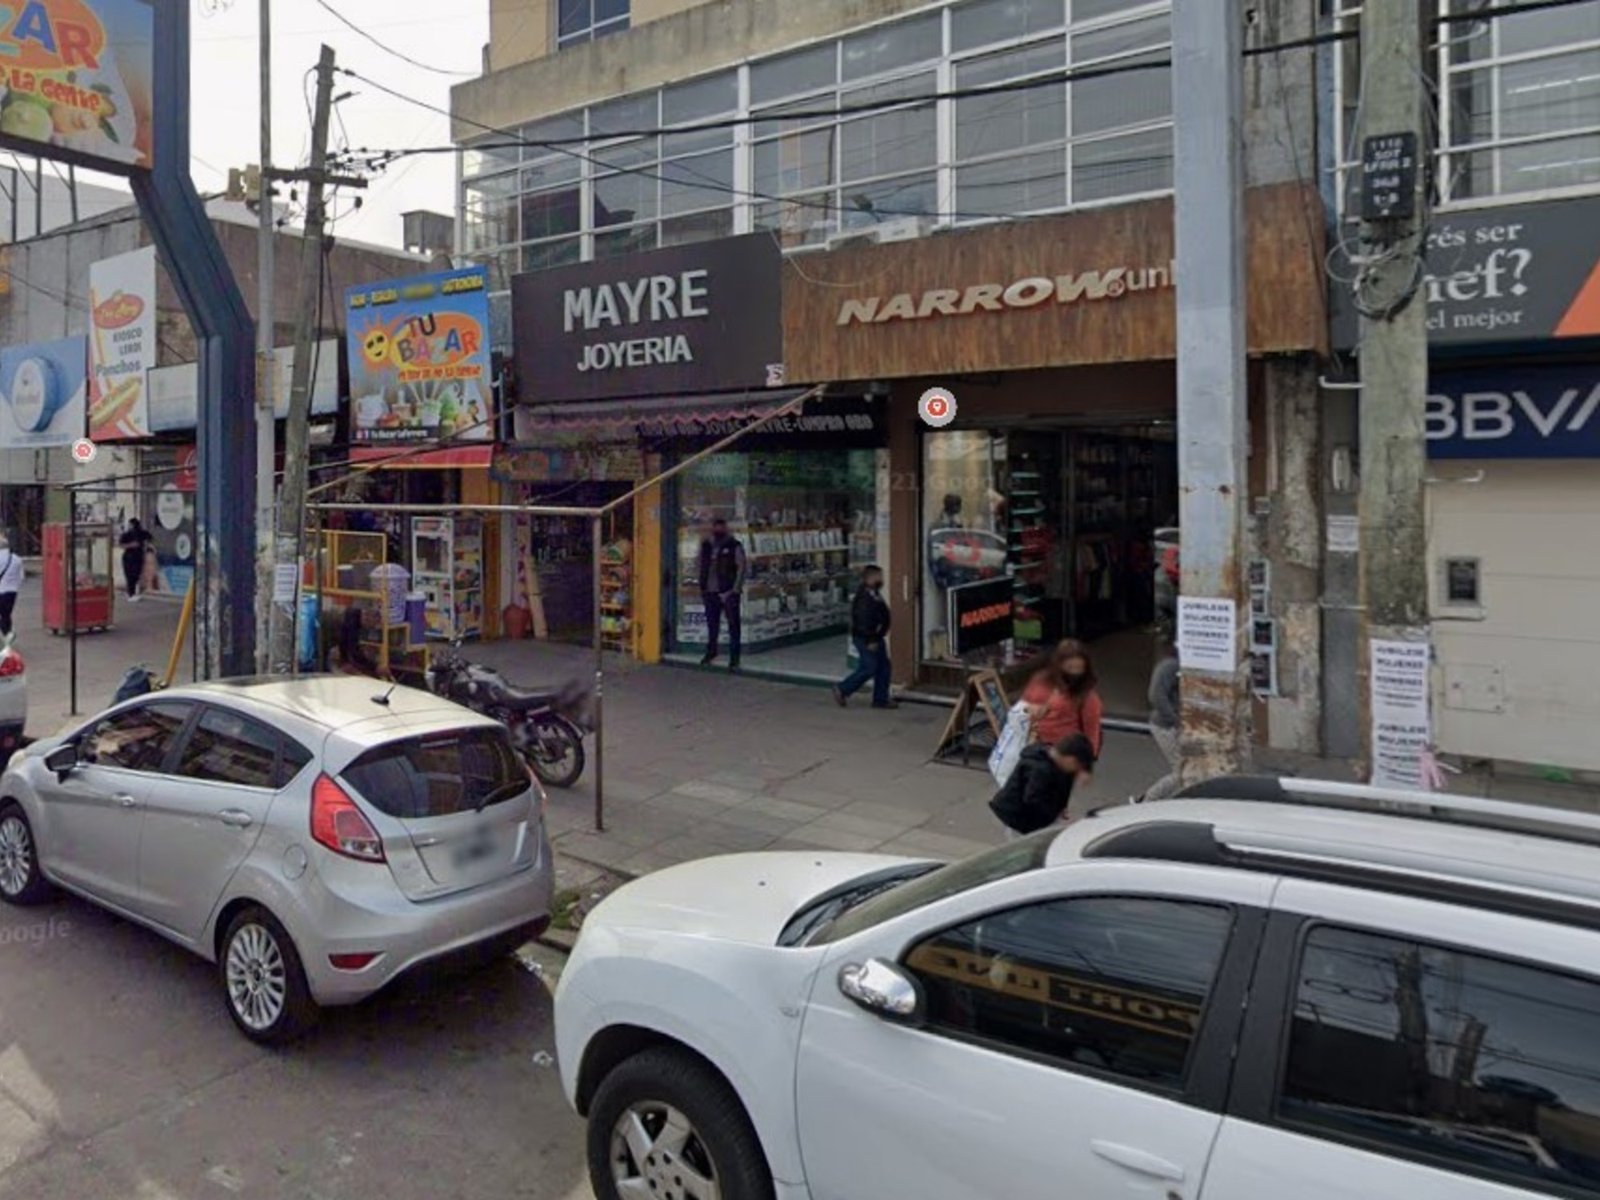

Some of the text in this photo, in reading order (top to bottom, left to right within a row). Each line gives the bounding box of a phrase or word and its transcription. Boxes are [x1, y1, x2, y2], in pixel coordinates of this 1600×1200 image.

[1475, 223, 1523, 242] ser
[563, 268, 709, 333] MAYRE
[836, 266, 1127, 326] NARROW
[404, 313, 436, 338] TU
[1453, 309, 1523, 330] mejor
[396, 327, 478, 364] BAZAR
[576, 334, 694, 372] JOYERIA
